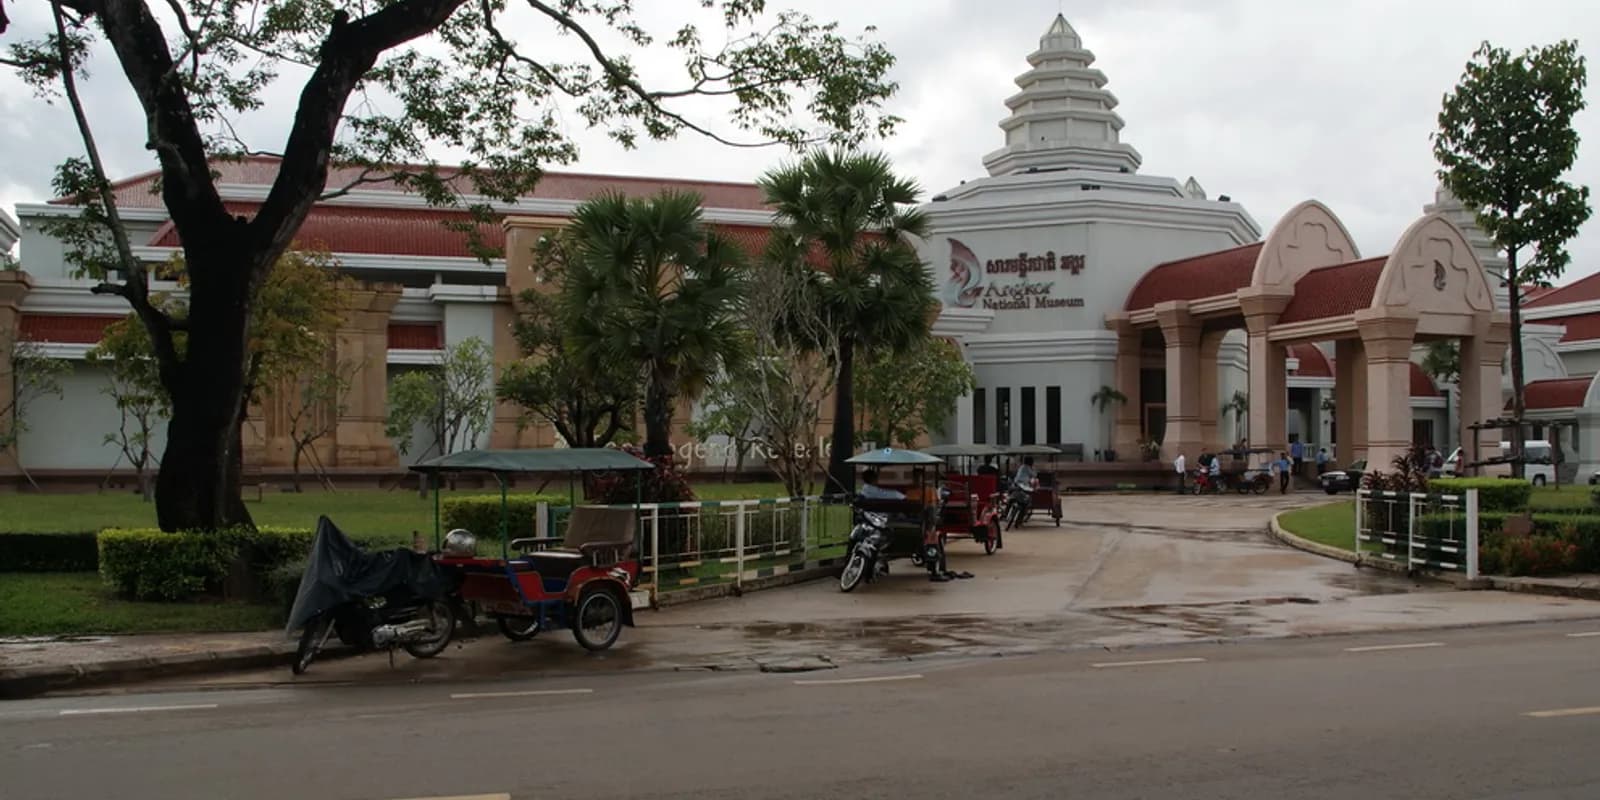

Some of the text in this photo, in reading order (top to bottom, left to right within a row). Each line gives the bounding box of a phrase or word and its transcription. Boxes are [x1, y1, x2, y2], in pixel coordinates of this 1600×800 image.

[983, 281, 1055, 300] Angkor
[982, 295, 1085, 310] National Museum
